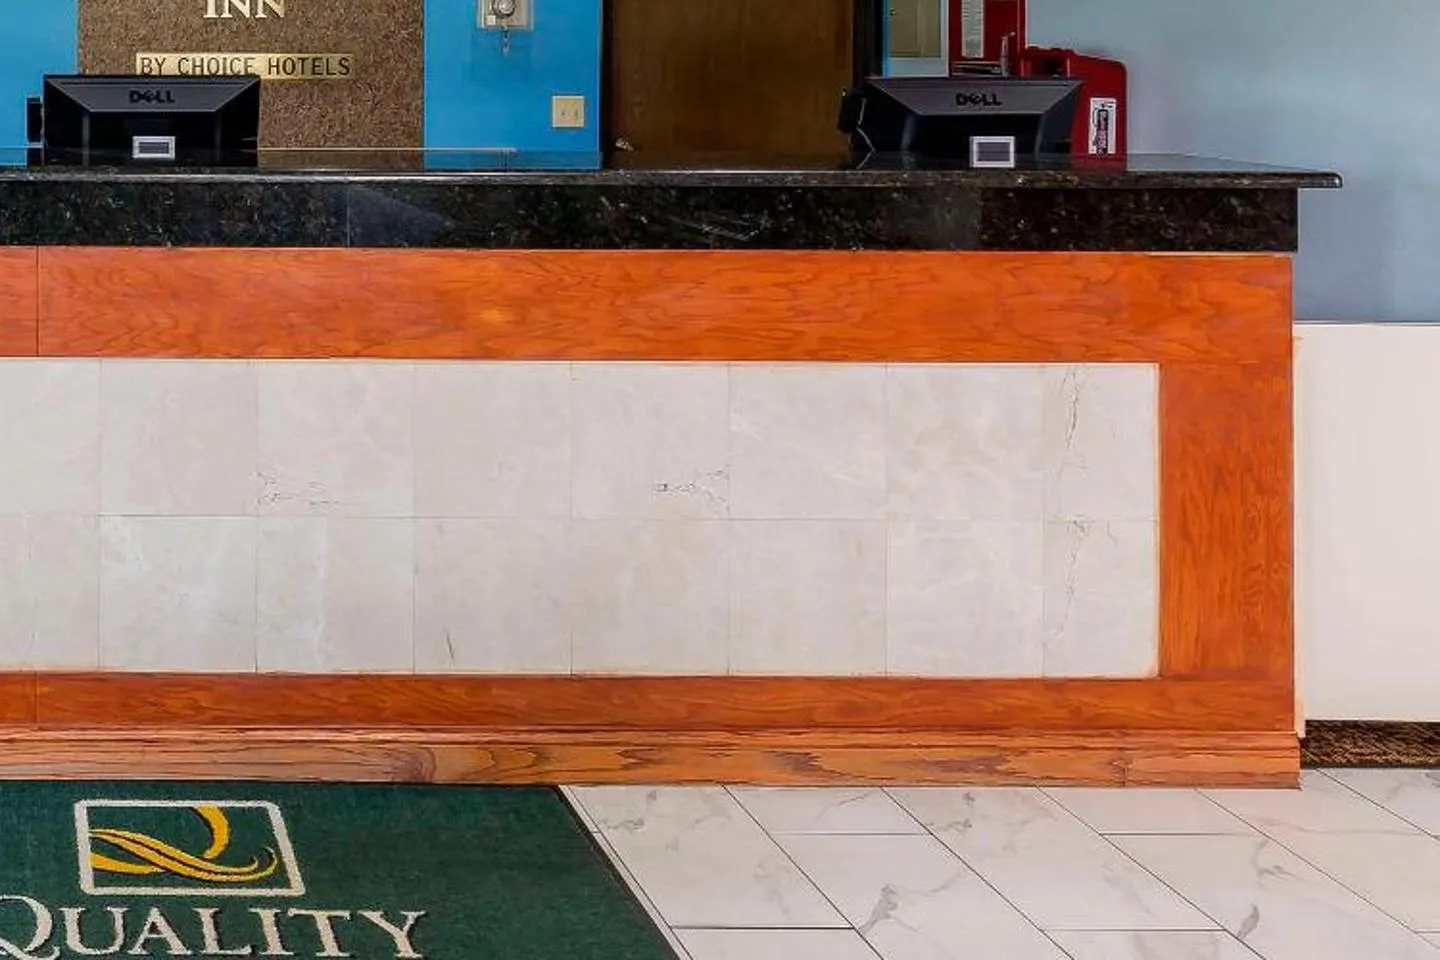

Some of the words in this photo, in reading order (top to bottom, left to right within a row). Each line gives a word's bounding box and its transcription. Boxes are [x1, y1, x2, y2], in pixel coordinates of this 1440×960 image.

[140, 56, 167, 75] BY
[177, 56, 256, 76] CHOICE
[267, 57, 351, 76] HOTELS
[129, 89, 176, 104] DELL
[955, 93, 1003, 106] DELL
